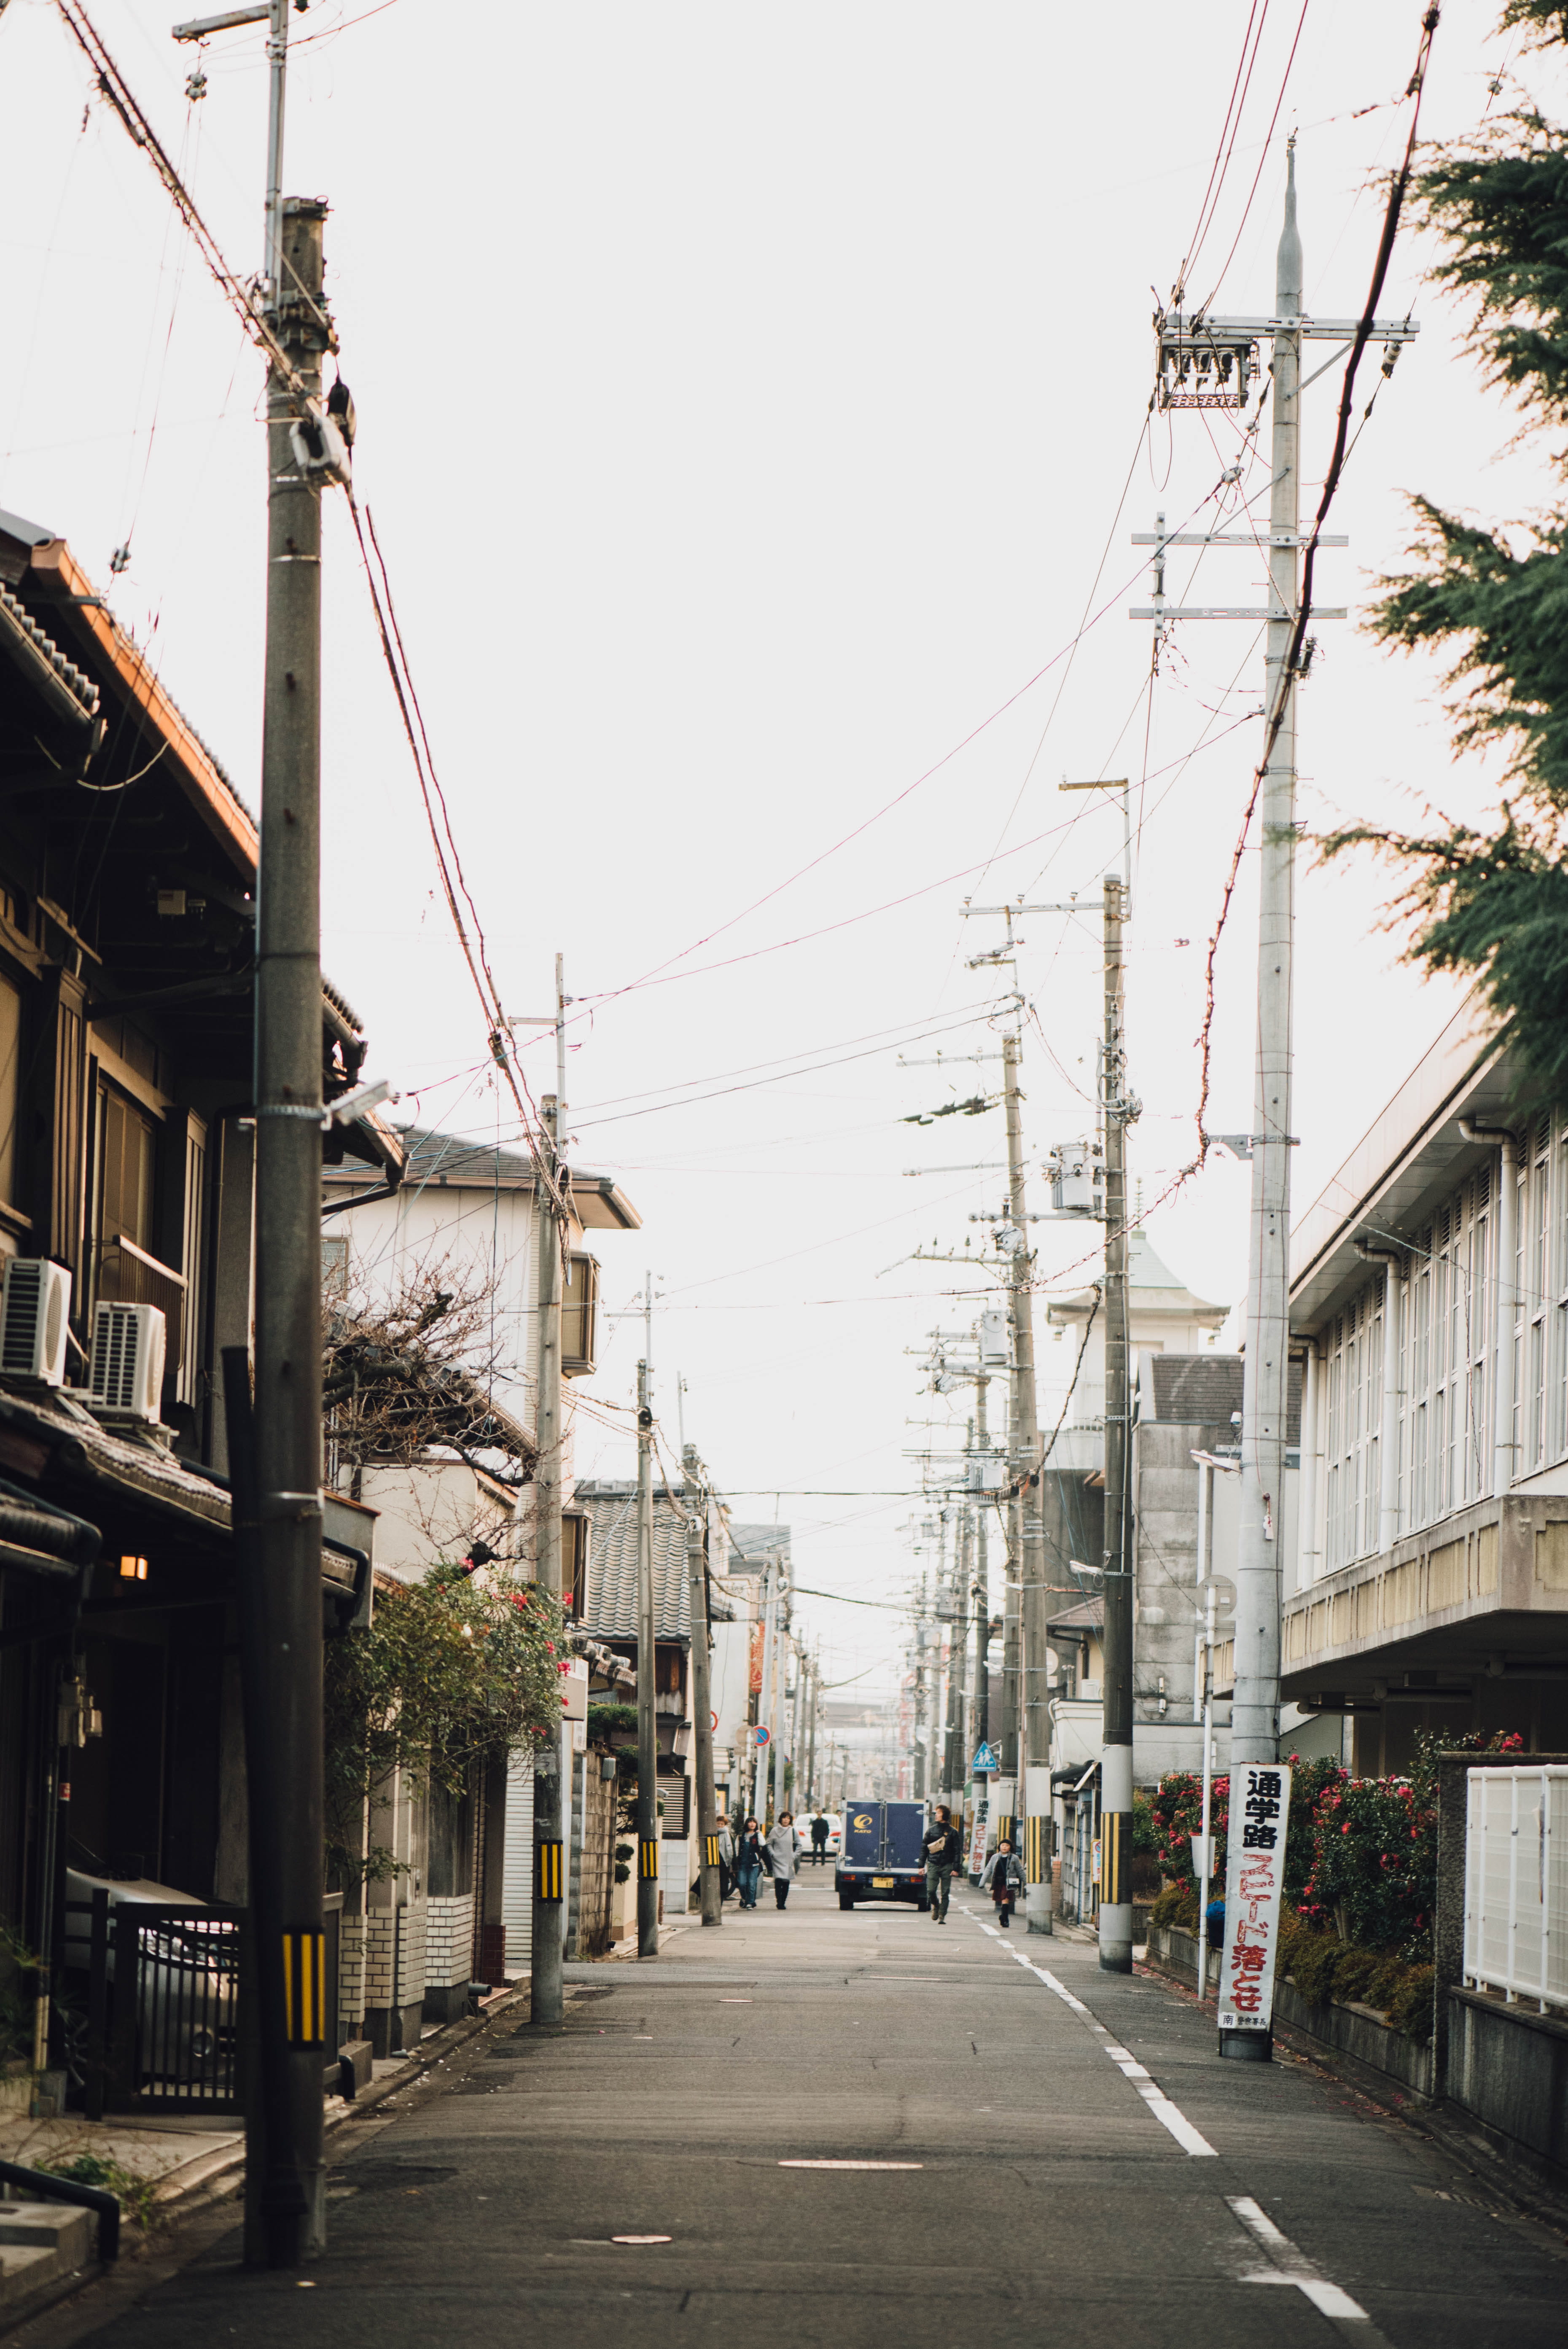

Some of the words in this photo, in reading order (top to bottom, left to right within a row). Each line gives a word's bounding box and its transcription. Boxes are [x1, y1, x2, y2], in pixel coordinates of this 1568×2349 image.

[977, 1800, 988, 1823] 通学路
[1243, 1770, 1281, 1850] 通学路
[1230, 1854, 1274, 2012] スピード落とせ
